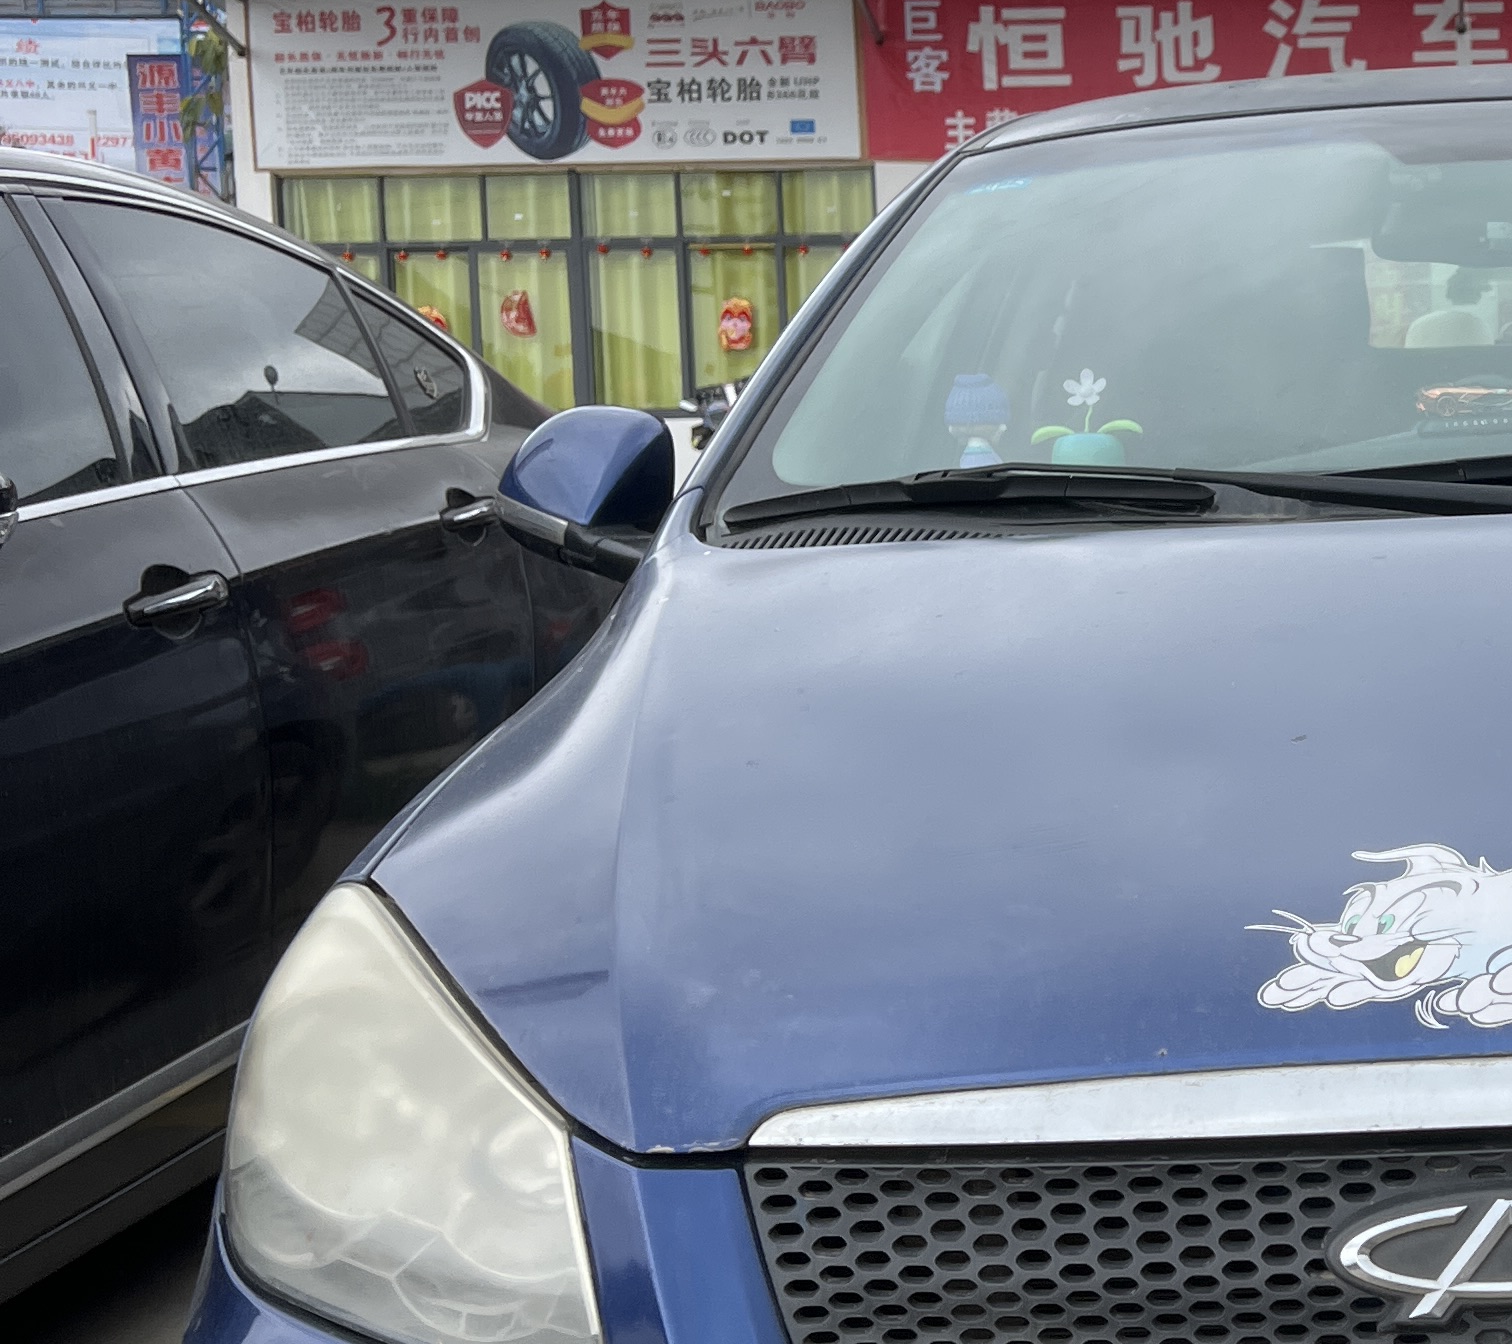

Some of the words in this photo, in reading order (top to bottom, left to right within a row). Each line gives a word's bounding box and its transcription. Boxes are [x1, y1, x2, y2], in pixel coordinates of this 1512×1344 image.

[273, 9, 361, 33] 宝柏轮胎
[645, 35, 817, 68] 三头六臂
[464, 91, 501, 109] PICC
[647, 76, 763, 104] 宝柏轮胎
[722, 130, 769, 145] DOT
